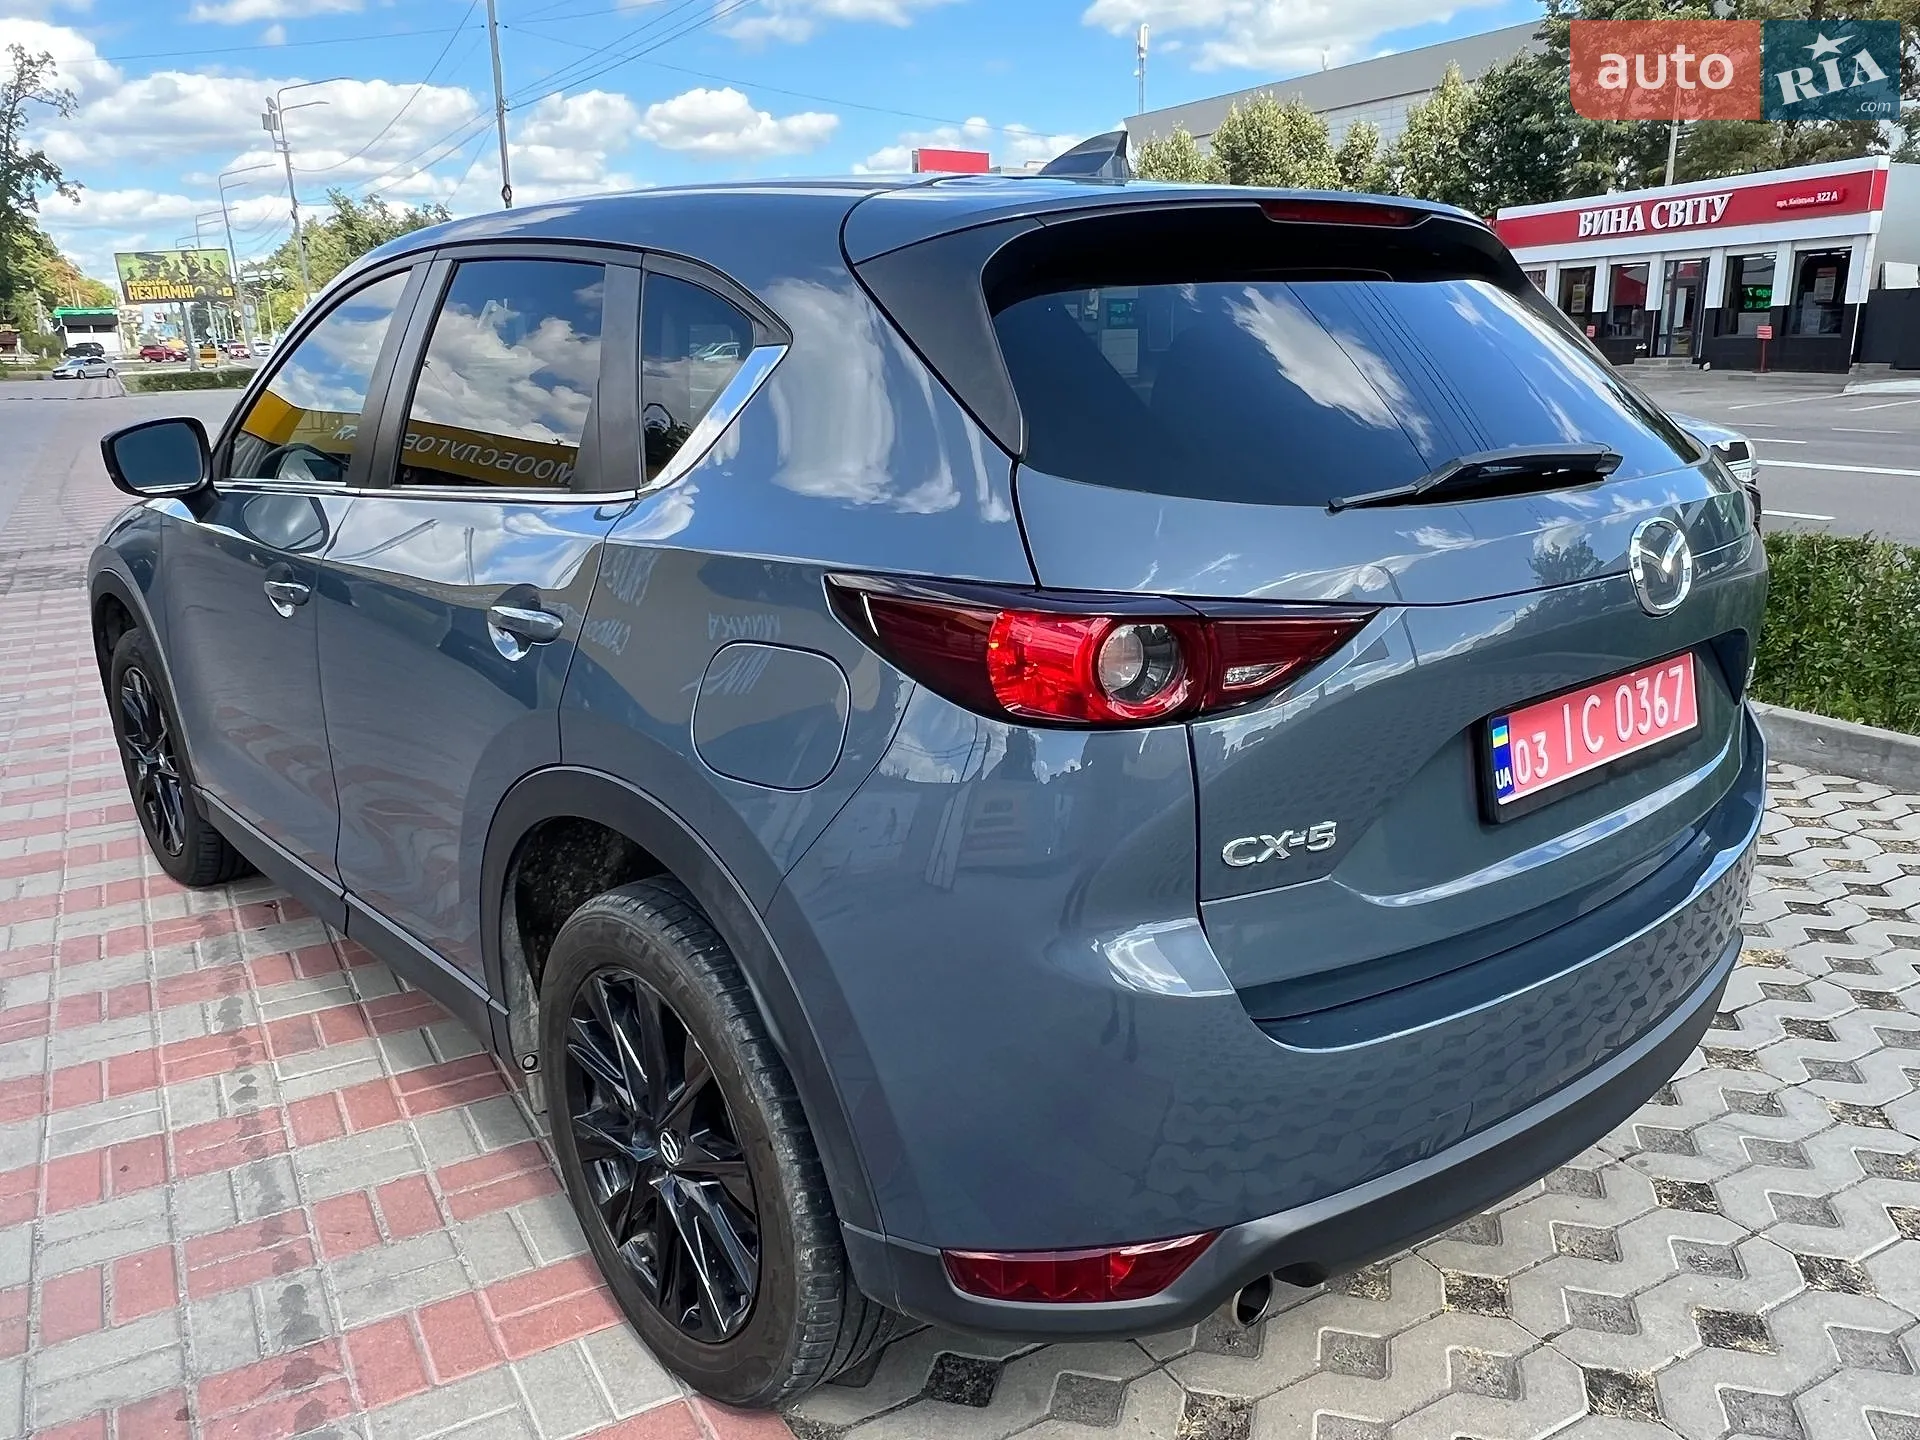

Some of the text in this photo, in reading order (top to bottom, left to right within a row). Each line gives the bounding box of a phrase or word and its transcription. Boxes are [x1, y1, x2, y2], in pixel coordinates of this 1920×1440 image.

[1577, 193, 1733, 238] ВИНА СВІТУ
[127, 284, 195, 301] НЕЗЛАМНІ
[1514, 664, 1685, 787] 03 IC 0367
[1495, 767, 1512, 790] UA
[1222, 820, 1337, 868] CX-5
